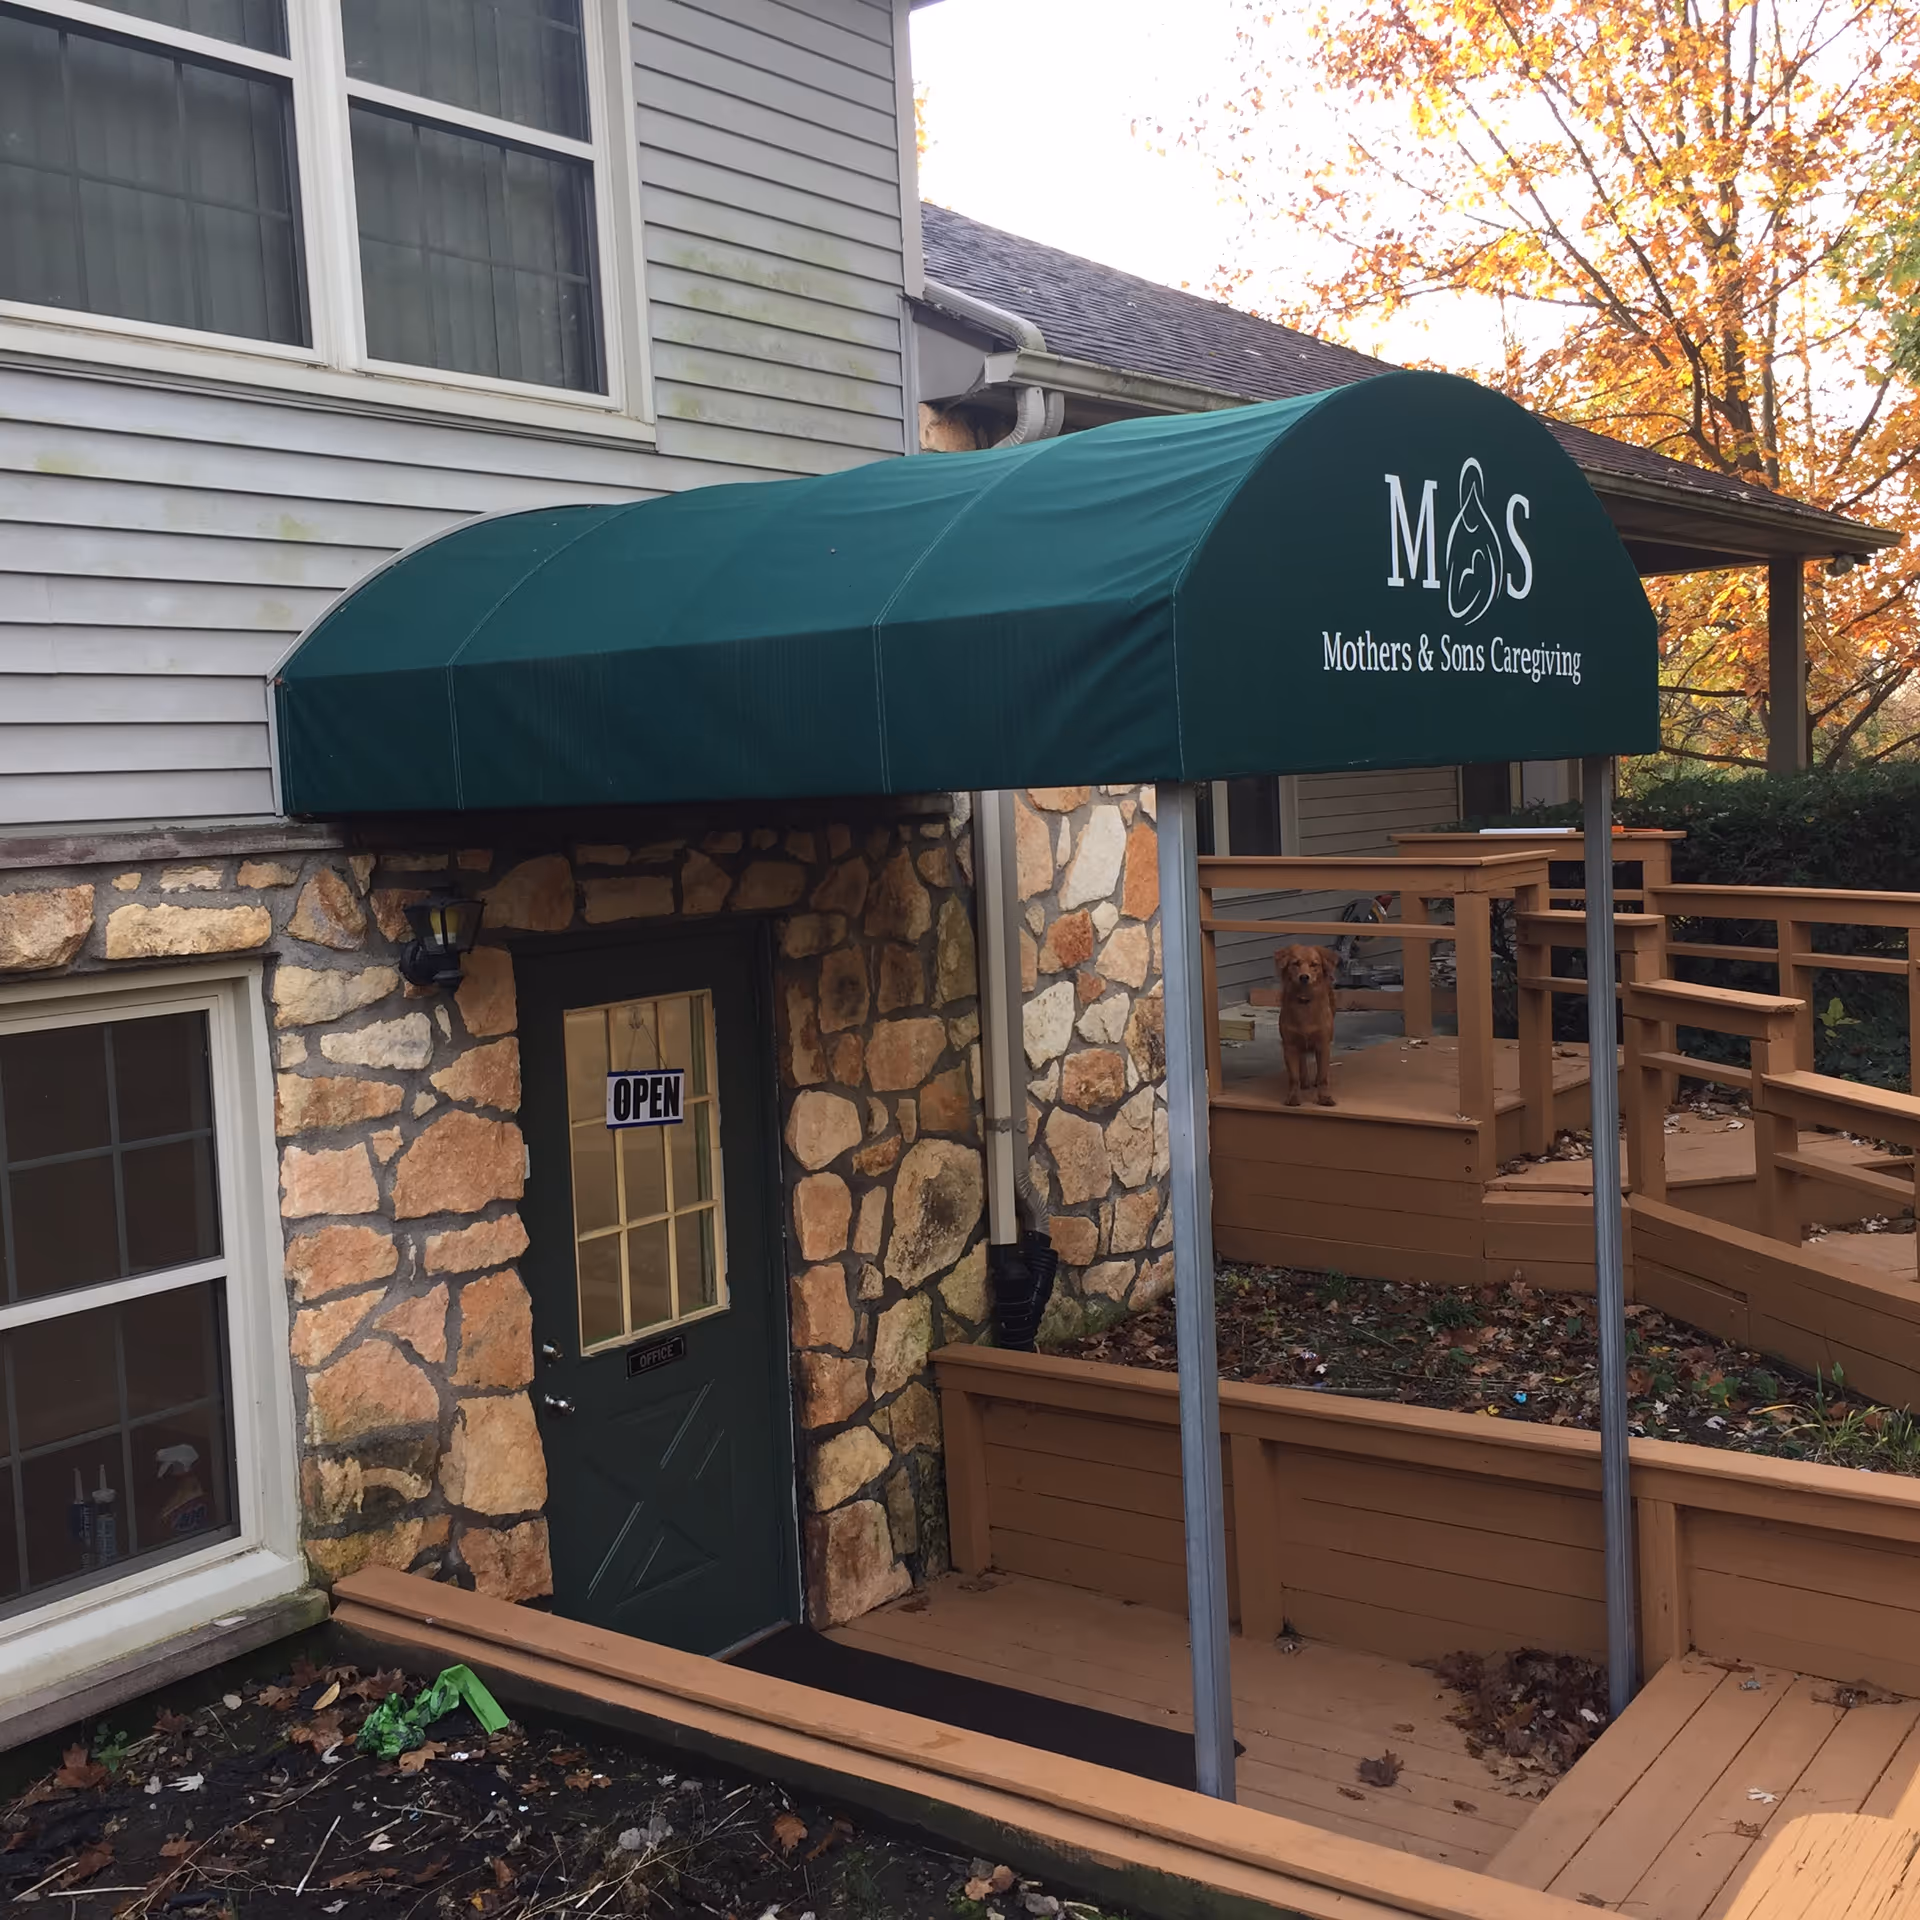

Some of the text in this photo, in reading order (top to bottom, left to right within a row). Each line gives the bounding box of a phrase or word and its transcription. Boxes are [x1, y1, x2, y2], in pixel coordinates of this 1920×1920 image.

[1322, 630, 1582, 685] Mothers & Sons Caregiving
[613, 1076, 680, 1121] OPEN
[640, 1344, 674, 1367] OFFICE
